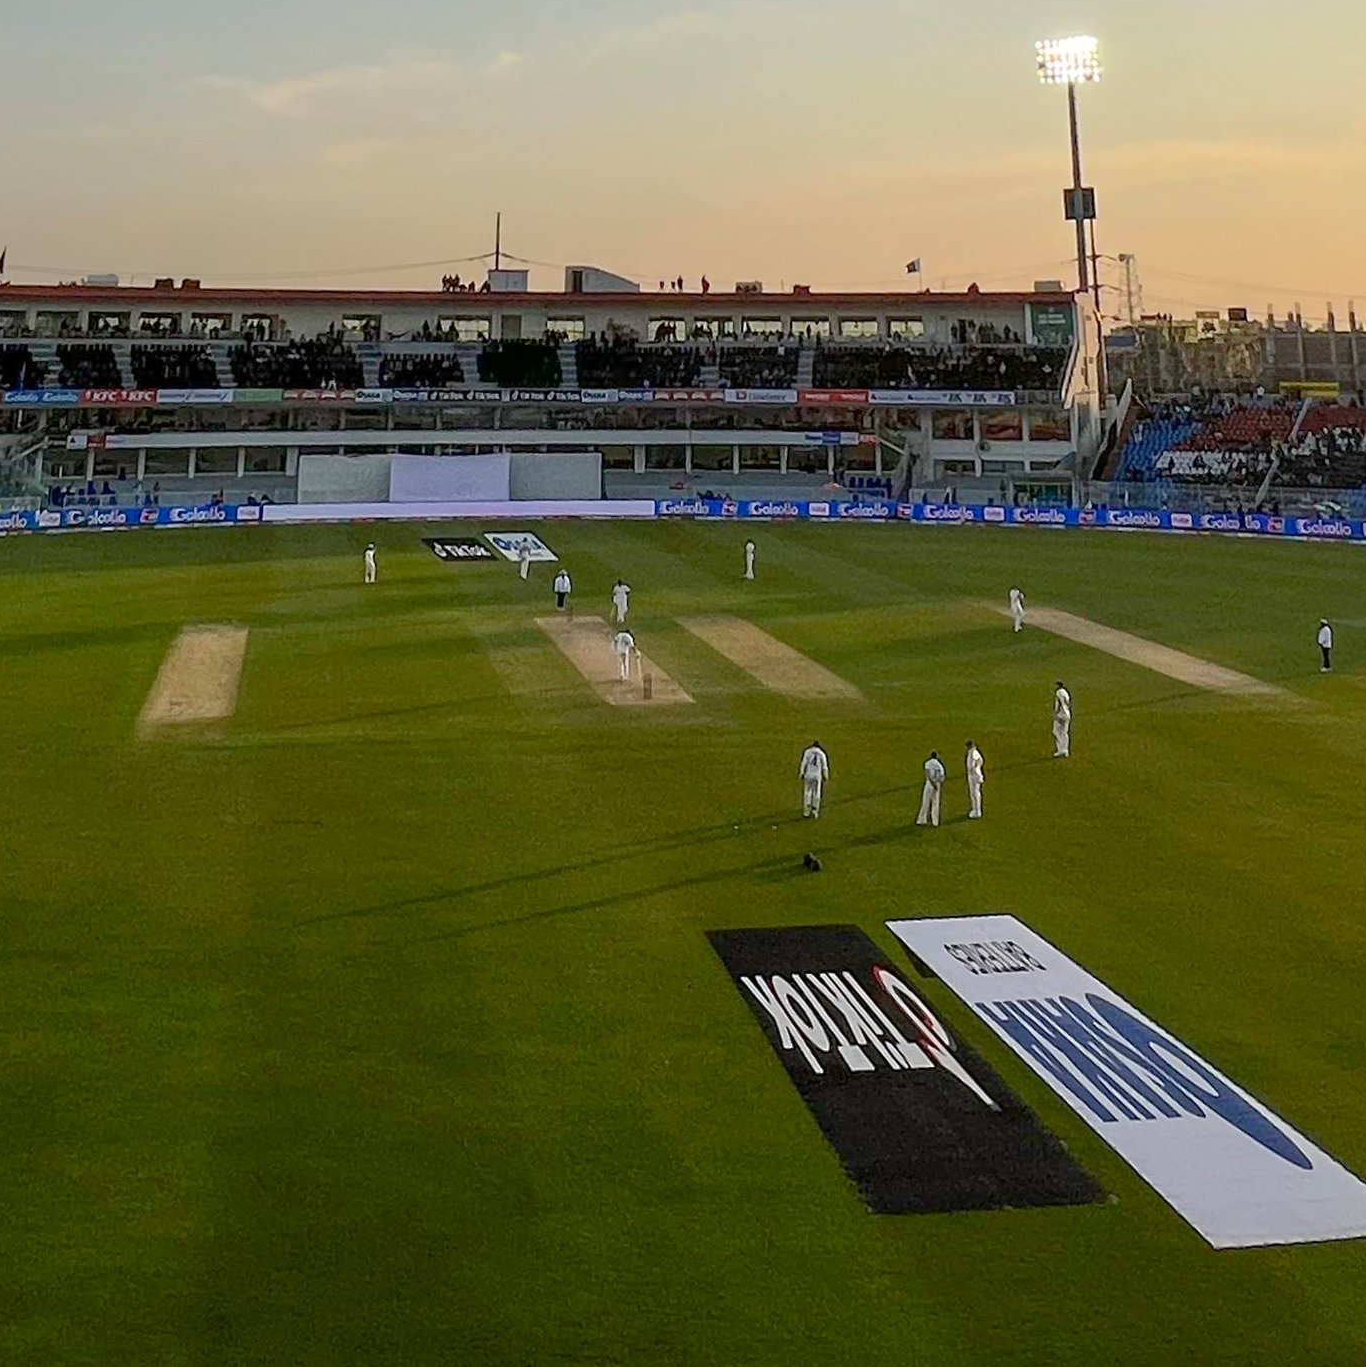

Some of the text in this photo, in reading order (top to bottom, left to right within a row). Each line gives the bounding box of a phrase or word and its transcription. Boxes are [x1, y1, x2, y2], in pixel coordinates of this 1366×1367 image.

[92, 390, 117, 402] KFC
[128, 390, 155, 401] KFC
[741, 971, 935, 1074] TikTok
[974, 992, 1314, 1170] OSAKA
